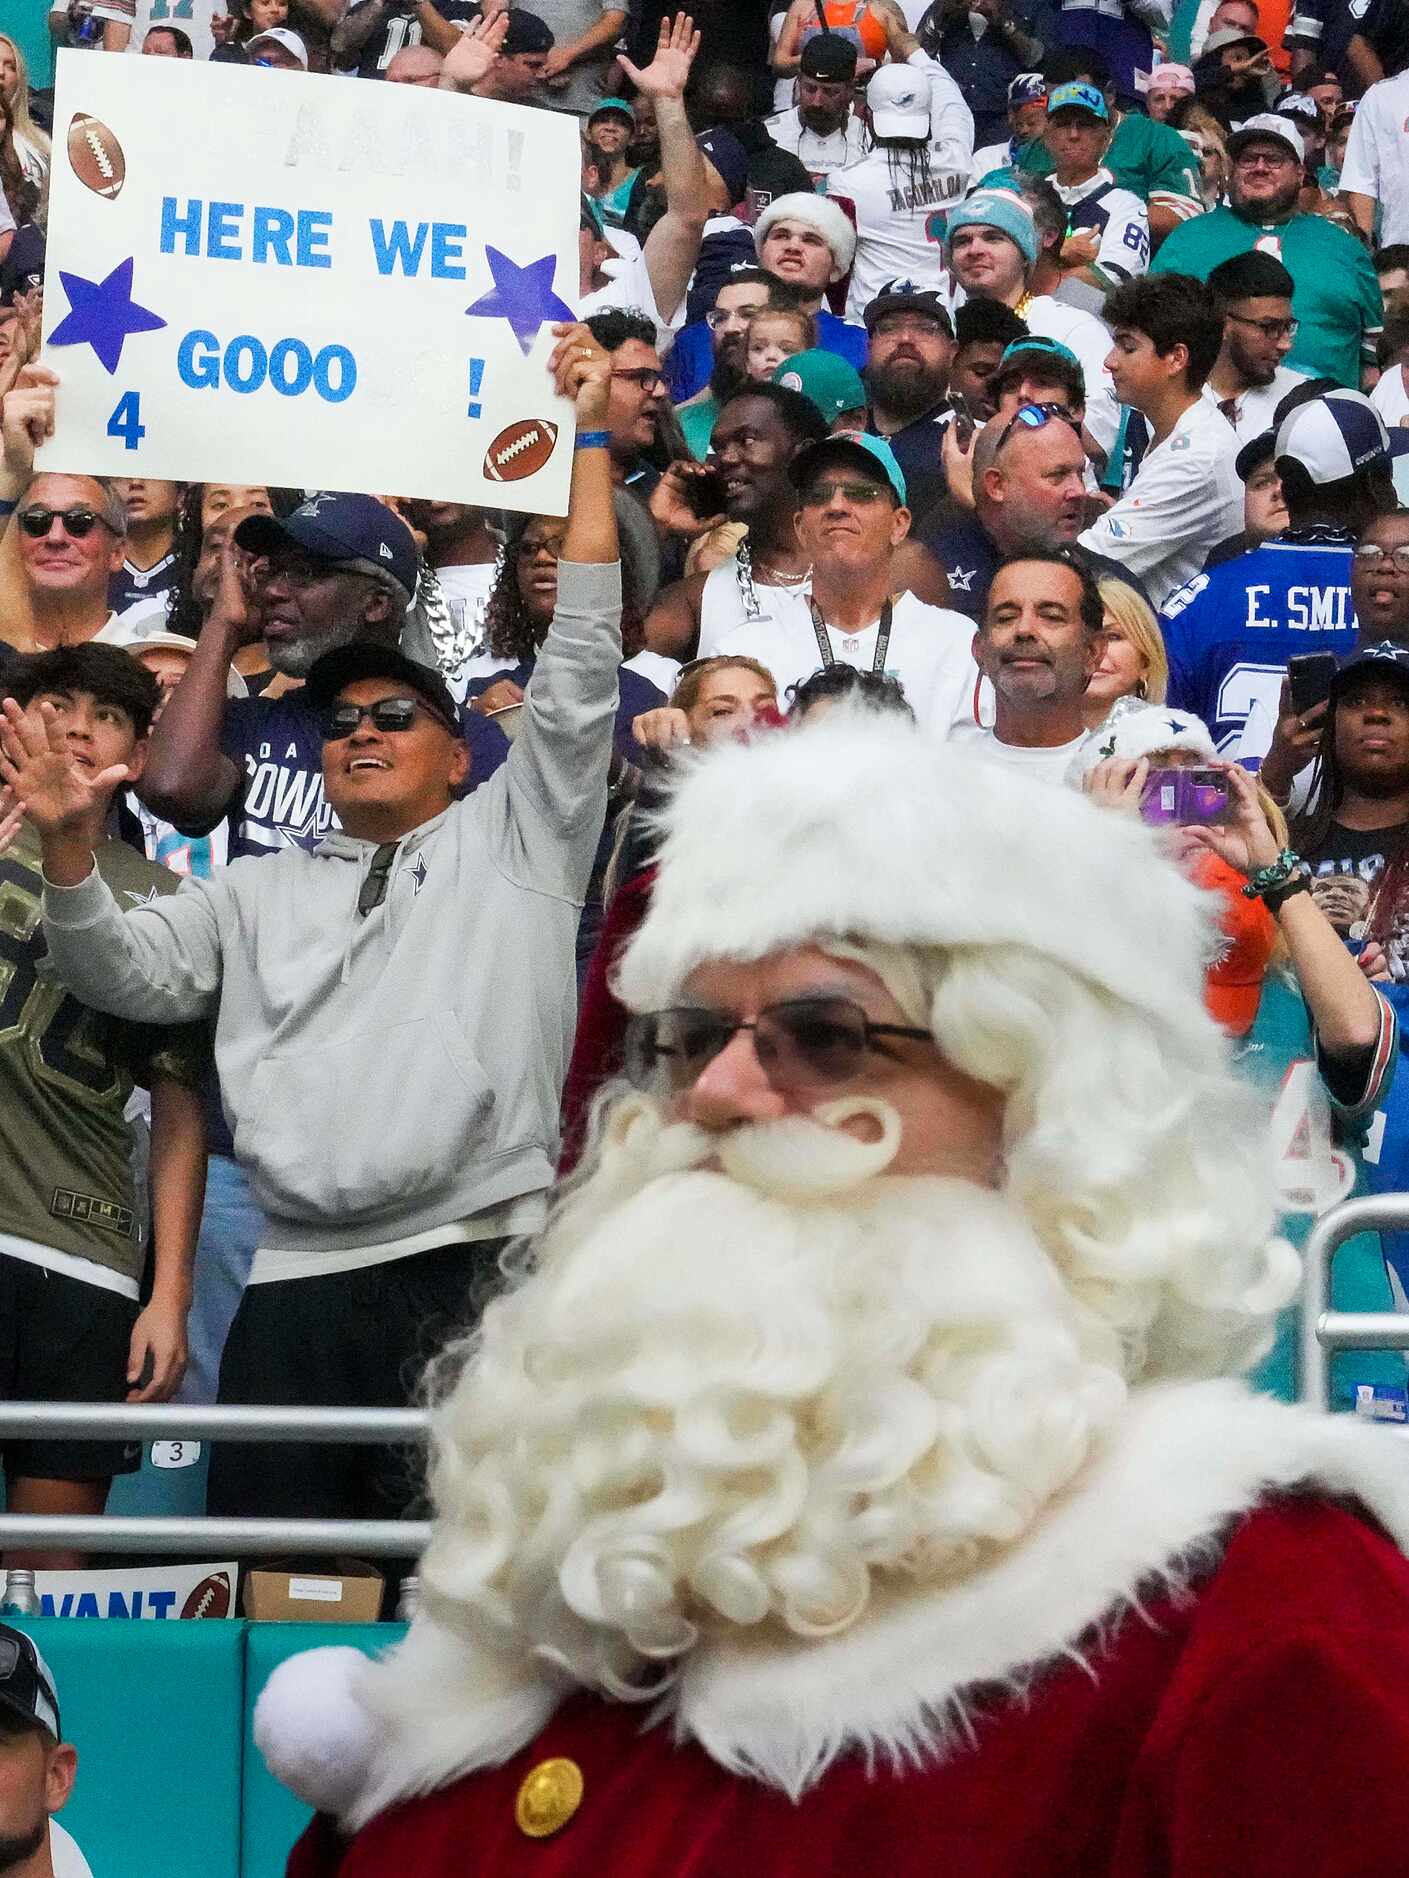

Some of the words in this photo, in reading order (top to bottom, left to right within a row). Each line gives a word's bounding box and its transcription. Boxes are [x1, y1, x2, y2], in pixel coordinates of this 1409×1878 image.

[159, 196, 334, 269] HERE
[368, 218, 468, 281] WE
[176, 328, 358, 403] GOOO
[466, 357, 486, 419] !
[106, 390, 146, 451] 4
[1245, 585, 1279, 628] E.
[169, 1441, 184, 1462] 3
[41, 1590, 176, 1619] ANT
